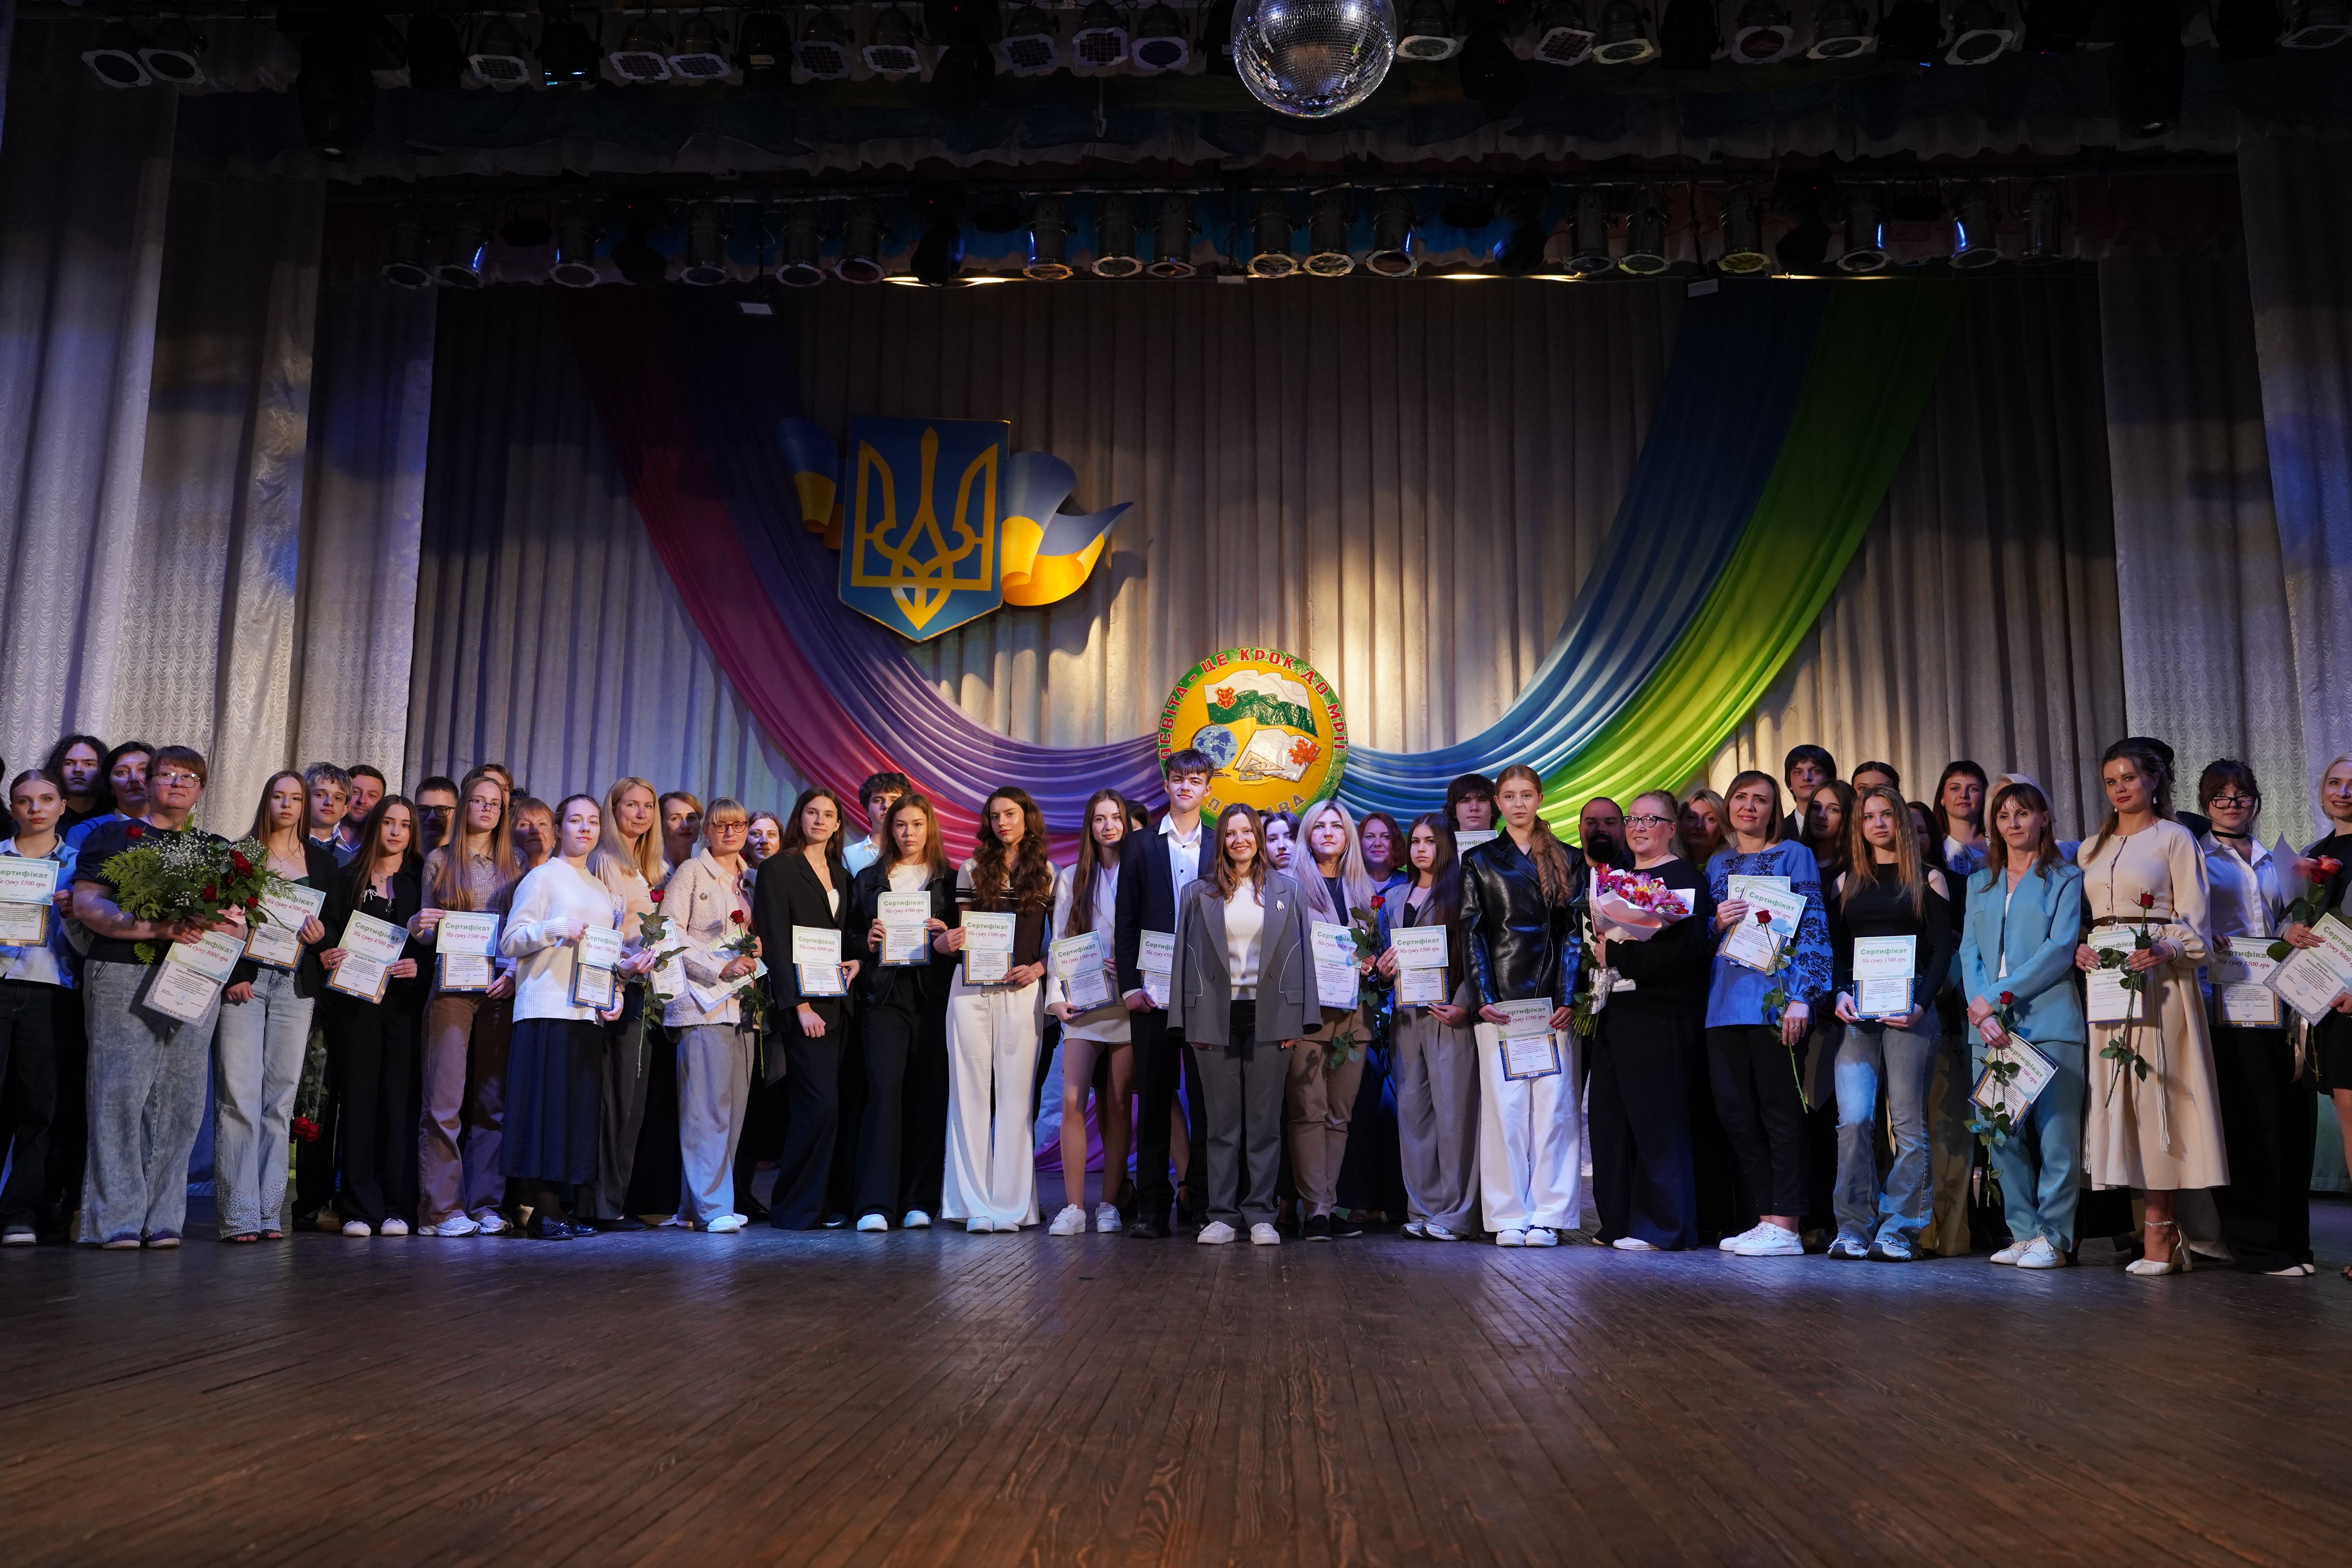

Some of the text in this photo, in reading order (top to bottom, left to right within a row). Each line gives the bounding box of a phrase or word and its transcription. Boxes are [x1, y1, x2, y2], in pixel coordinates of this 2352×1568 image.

[1160, 686, 1189, 760] ОСВІТА
[1200, 653, 1229, 674] ЦЕ
[1240, 648, 1295, 670] КРОК
[1300, 670, 1329, 695] ДО
[1326, 703, 1348, 750] МРІЇ
[1749, 892, 1795, 911] Сертифікат
[355, 922, 399, 941] Сертифікат
[446, 923, 490, 931] Сертифікат
[586, 934, 618, 946] Сертифікат
[798, 936, 835, 945] Сертифікат
[1058, 944, 1095, 957] Сертифікат
[2327, 942, 2339, 953] суму
[2339, 951, 2351, 962] 9000
[2009, 1047, 2043, 1078] ертифікат
